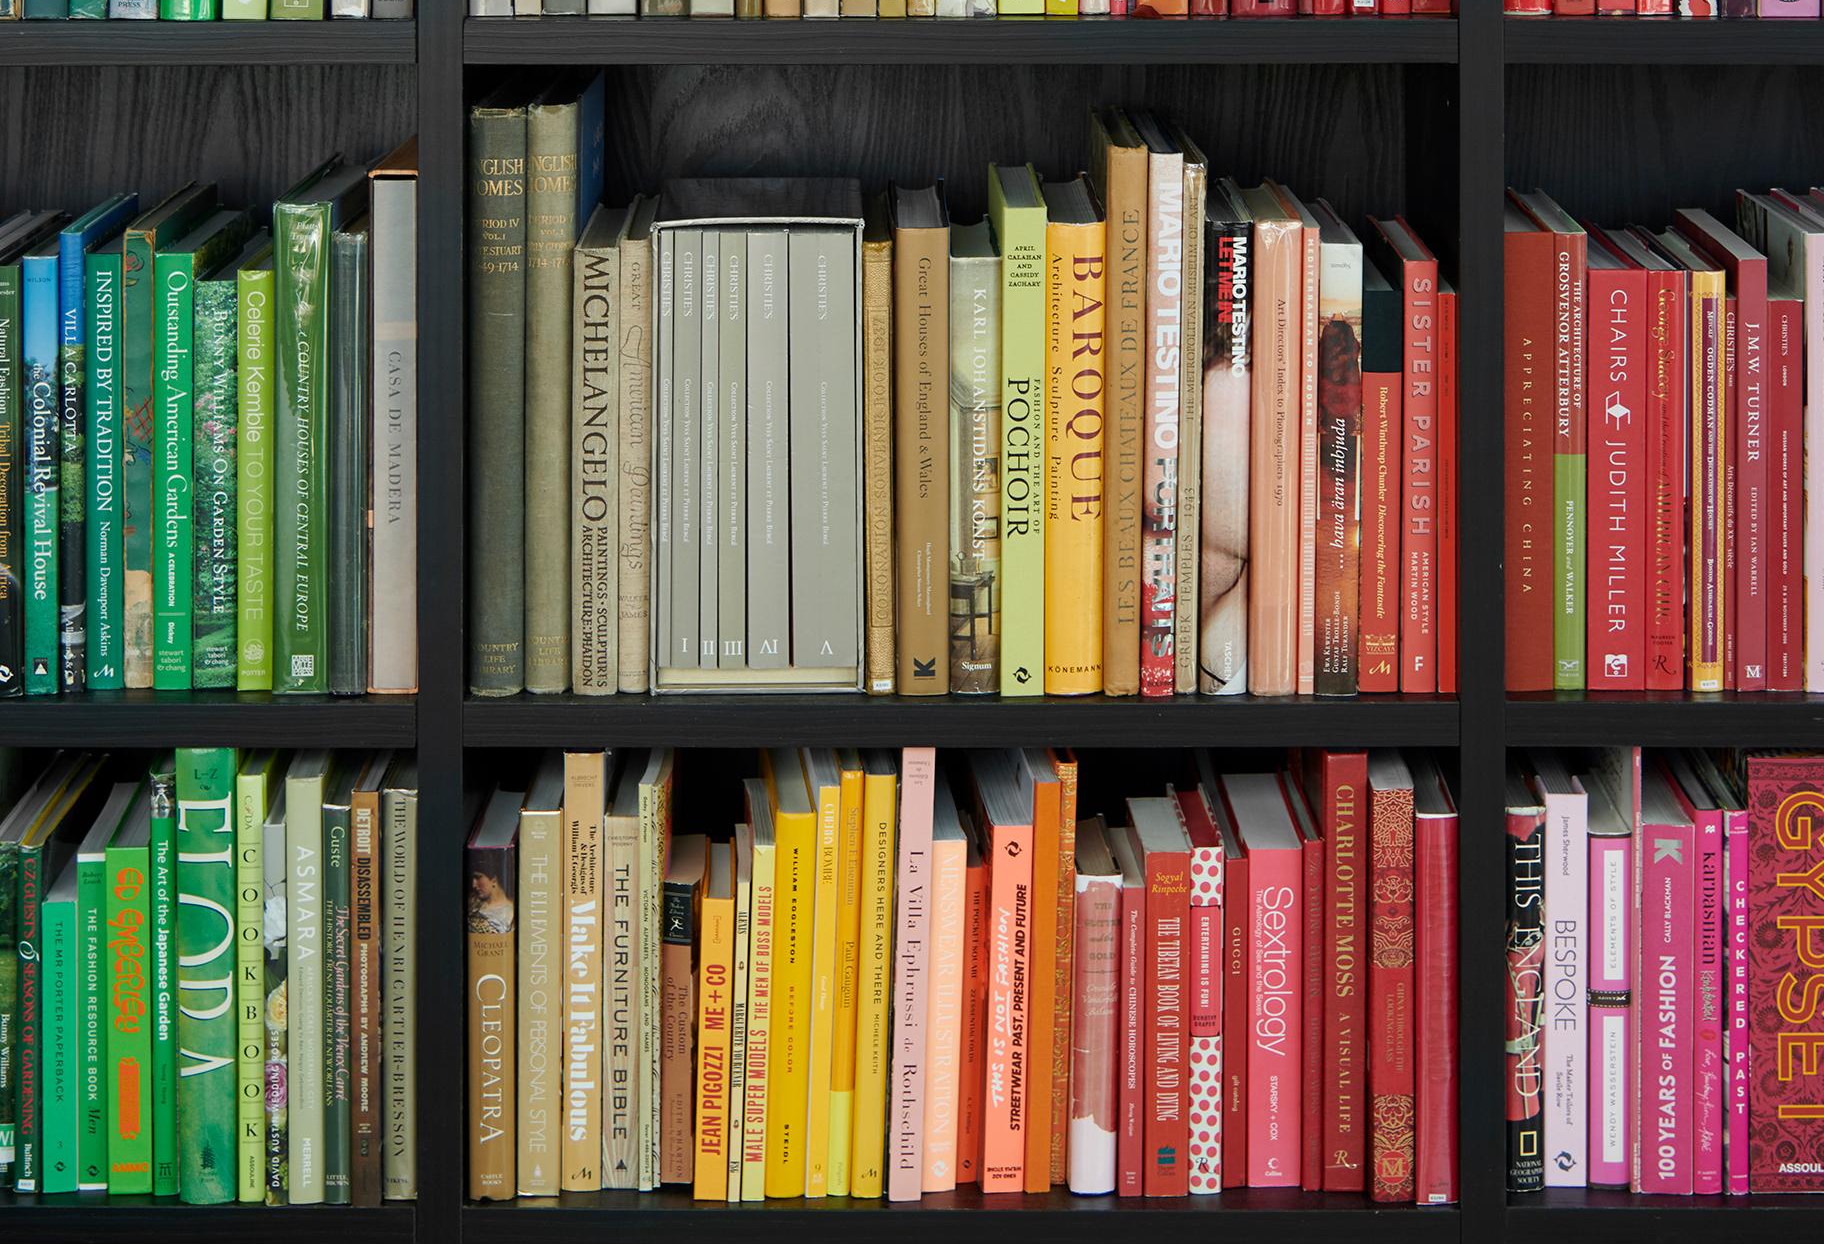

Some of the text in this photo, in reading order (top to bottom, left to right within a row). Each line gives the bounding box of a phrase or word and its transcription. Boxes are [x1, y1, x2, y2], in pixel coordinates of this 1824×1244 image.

[96, 271, 112, 511] INSPIRED BY TRADITION
[582, 254, 610, 521] MICHELANGELO
[1049, 253, 1062, 520] Architecture Sculpture Painting
[1065, 253, 1103, 522] BAROQUE
[1231, 237, 1246, 378] MARIO TESTINO
[1558, 251, 1571, 436] GROSVENOR ATTERBURY
[163, 271, 187, 548] Outstanding American Gardens
[389, 351, 401, 524] CASA DE MADERA
[1006, 378, 1030, 538] POCHOIR
[1411, 278, 1431, 536] SISTER PARISH
[1606, 290, 1628, 632] CHAIRS JUDITH MILLER
[99, 521, 110, 656] Norman Davenport Askins
[1410, 552, 1418, 619] MARTIN WOOD
[1421, 552, 1429, 634] AMERICAN STYLE
[156, 840, 170, 1040] The Art of the Japanese Garden
[297, 845, 314, 960] ASMARA
[357, 809, 371, 940] DETROIT DISASSEMBLED
[1335, 785, 1354, 997] CHARLOTTE MOSS
[477, 974, 506, 1143] CLEOPATRA
[571, 899, 595, 1141] Make It Fabulous
[614, 864, 629, 1139] THE FURNITURE BIBLE
[705, 964, 725, 1030] ME + CO
[899, 850, 925, 1170] La Villa Ephrussi de Rothschild
[1257, 886, 1294, 1055] Sextrology
[1554, 920, 1577, 1031] BESPOKE
[1736, 881, 1745, 1114] CHECKERED PAST
[702, 1046, 723, 1155] JEAN PIGOZZI
[1658, 956, 1677, 1179] 100 YEARS OF FASHION
[303, 1137, 311, 1187] MERRELL
